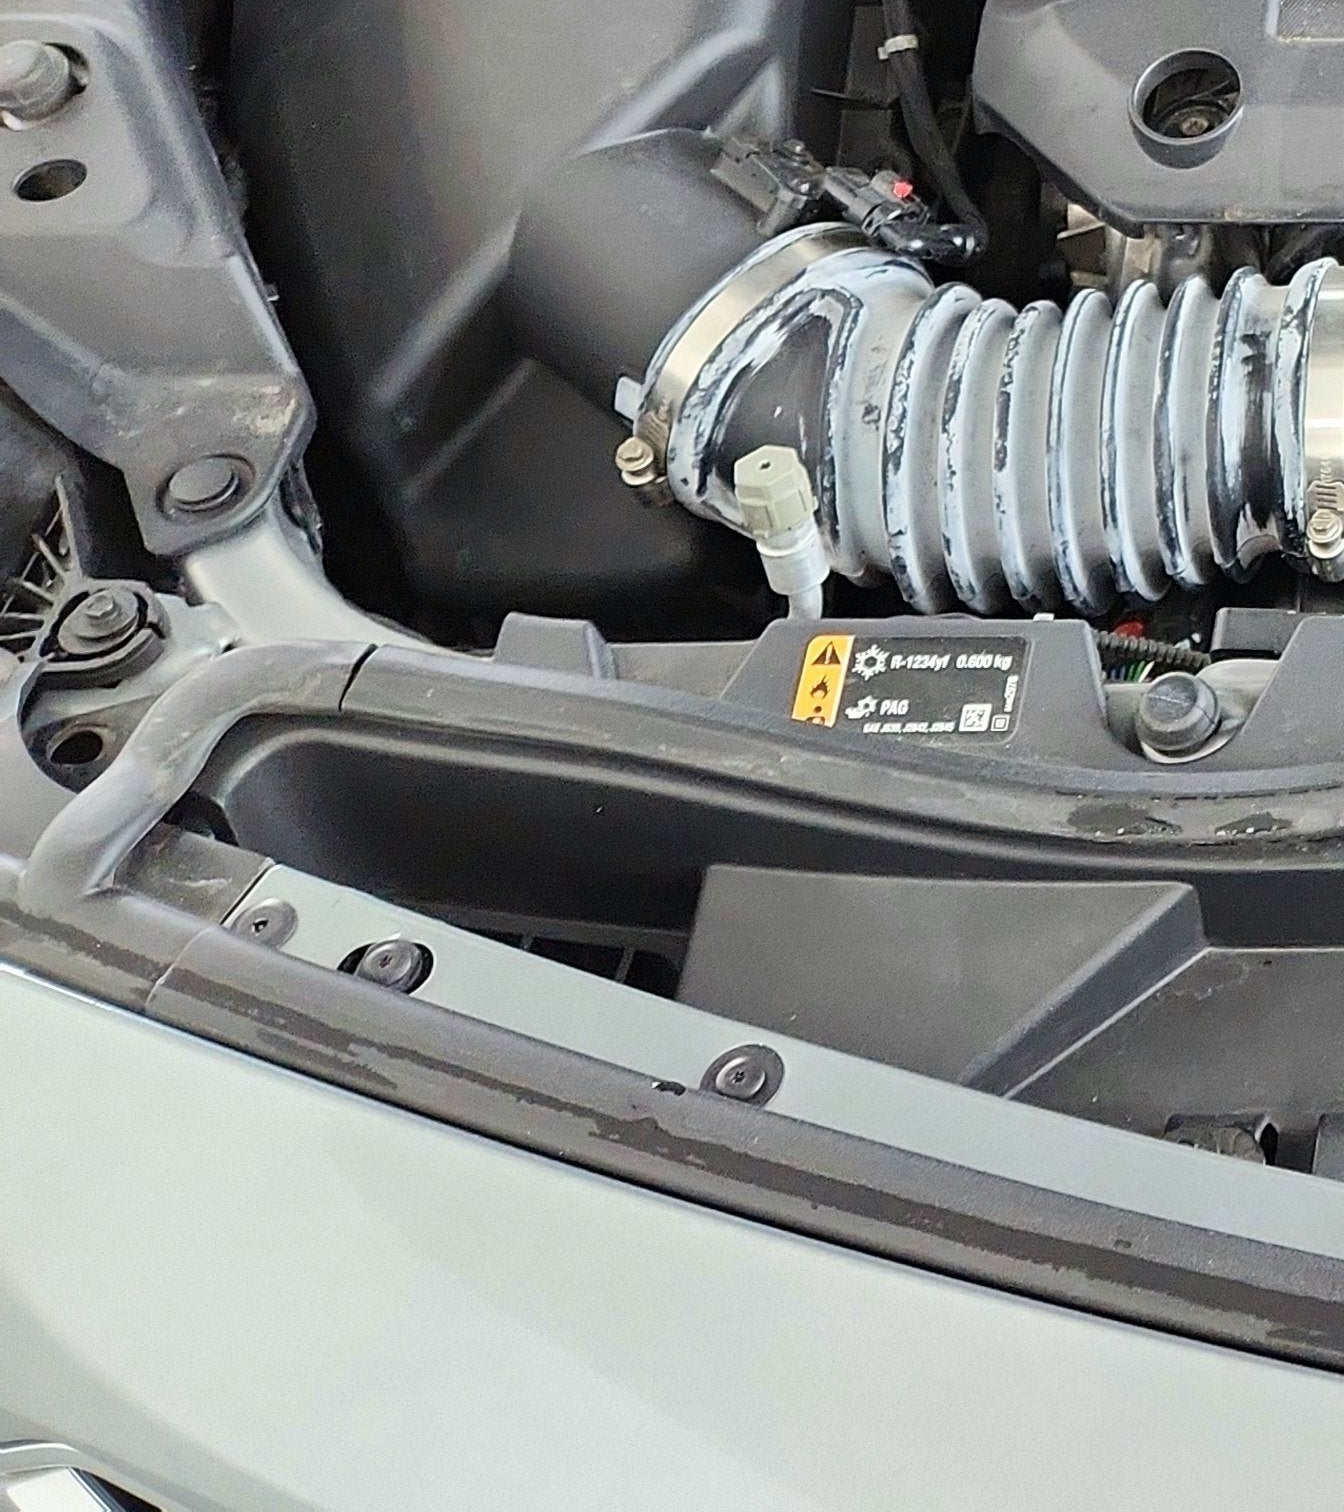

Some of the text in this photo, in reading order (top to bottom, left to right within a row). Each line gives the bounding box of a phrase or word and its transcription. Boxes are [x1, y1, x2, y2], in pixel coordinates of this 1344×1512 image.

[890, 654, 951, 672] R-1234yf
[993, 655, 1013, 672] kg
[880, 699, 910, 716] PAG
